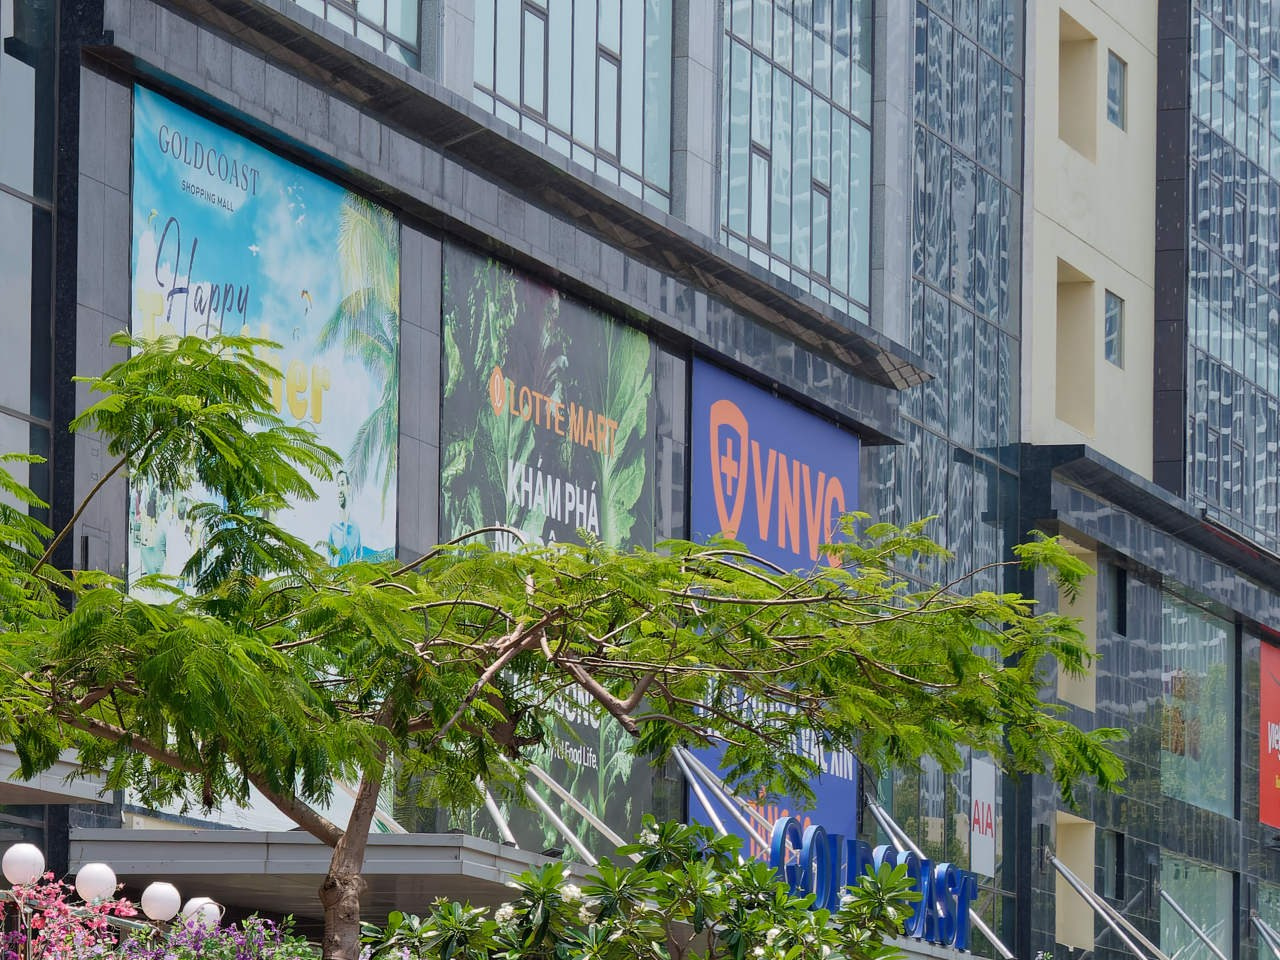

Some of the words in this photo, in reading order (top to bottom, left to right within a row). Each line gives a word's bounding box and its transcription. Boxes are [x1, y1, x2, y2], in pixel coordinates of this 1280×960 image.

[158, 124, 260, 196] GOLDCOAST
[181, 179, 216, 205] SHOPPING
[217, 196, 235, 213] MALL
[155, 216, 251, 338] Happy
[508, 379, 565, 437] LOTTE
[568, 401, 619, 460] MART
[506, 457, 561, 522] KHÁM
[564, 480, 600, 537] PHÁ
[751, 439, 846, 569] VNVC
[971, 799, 994, 839] AIA
